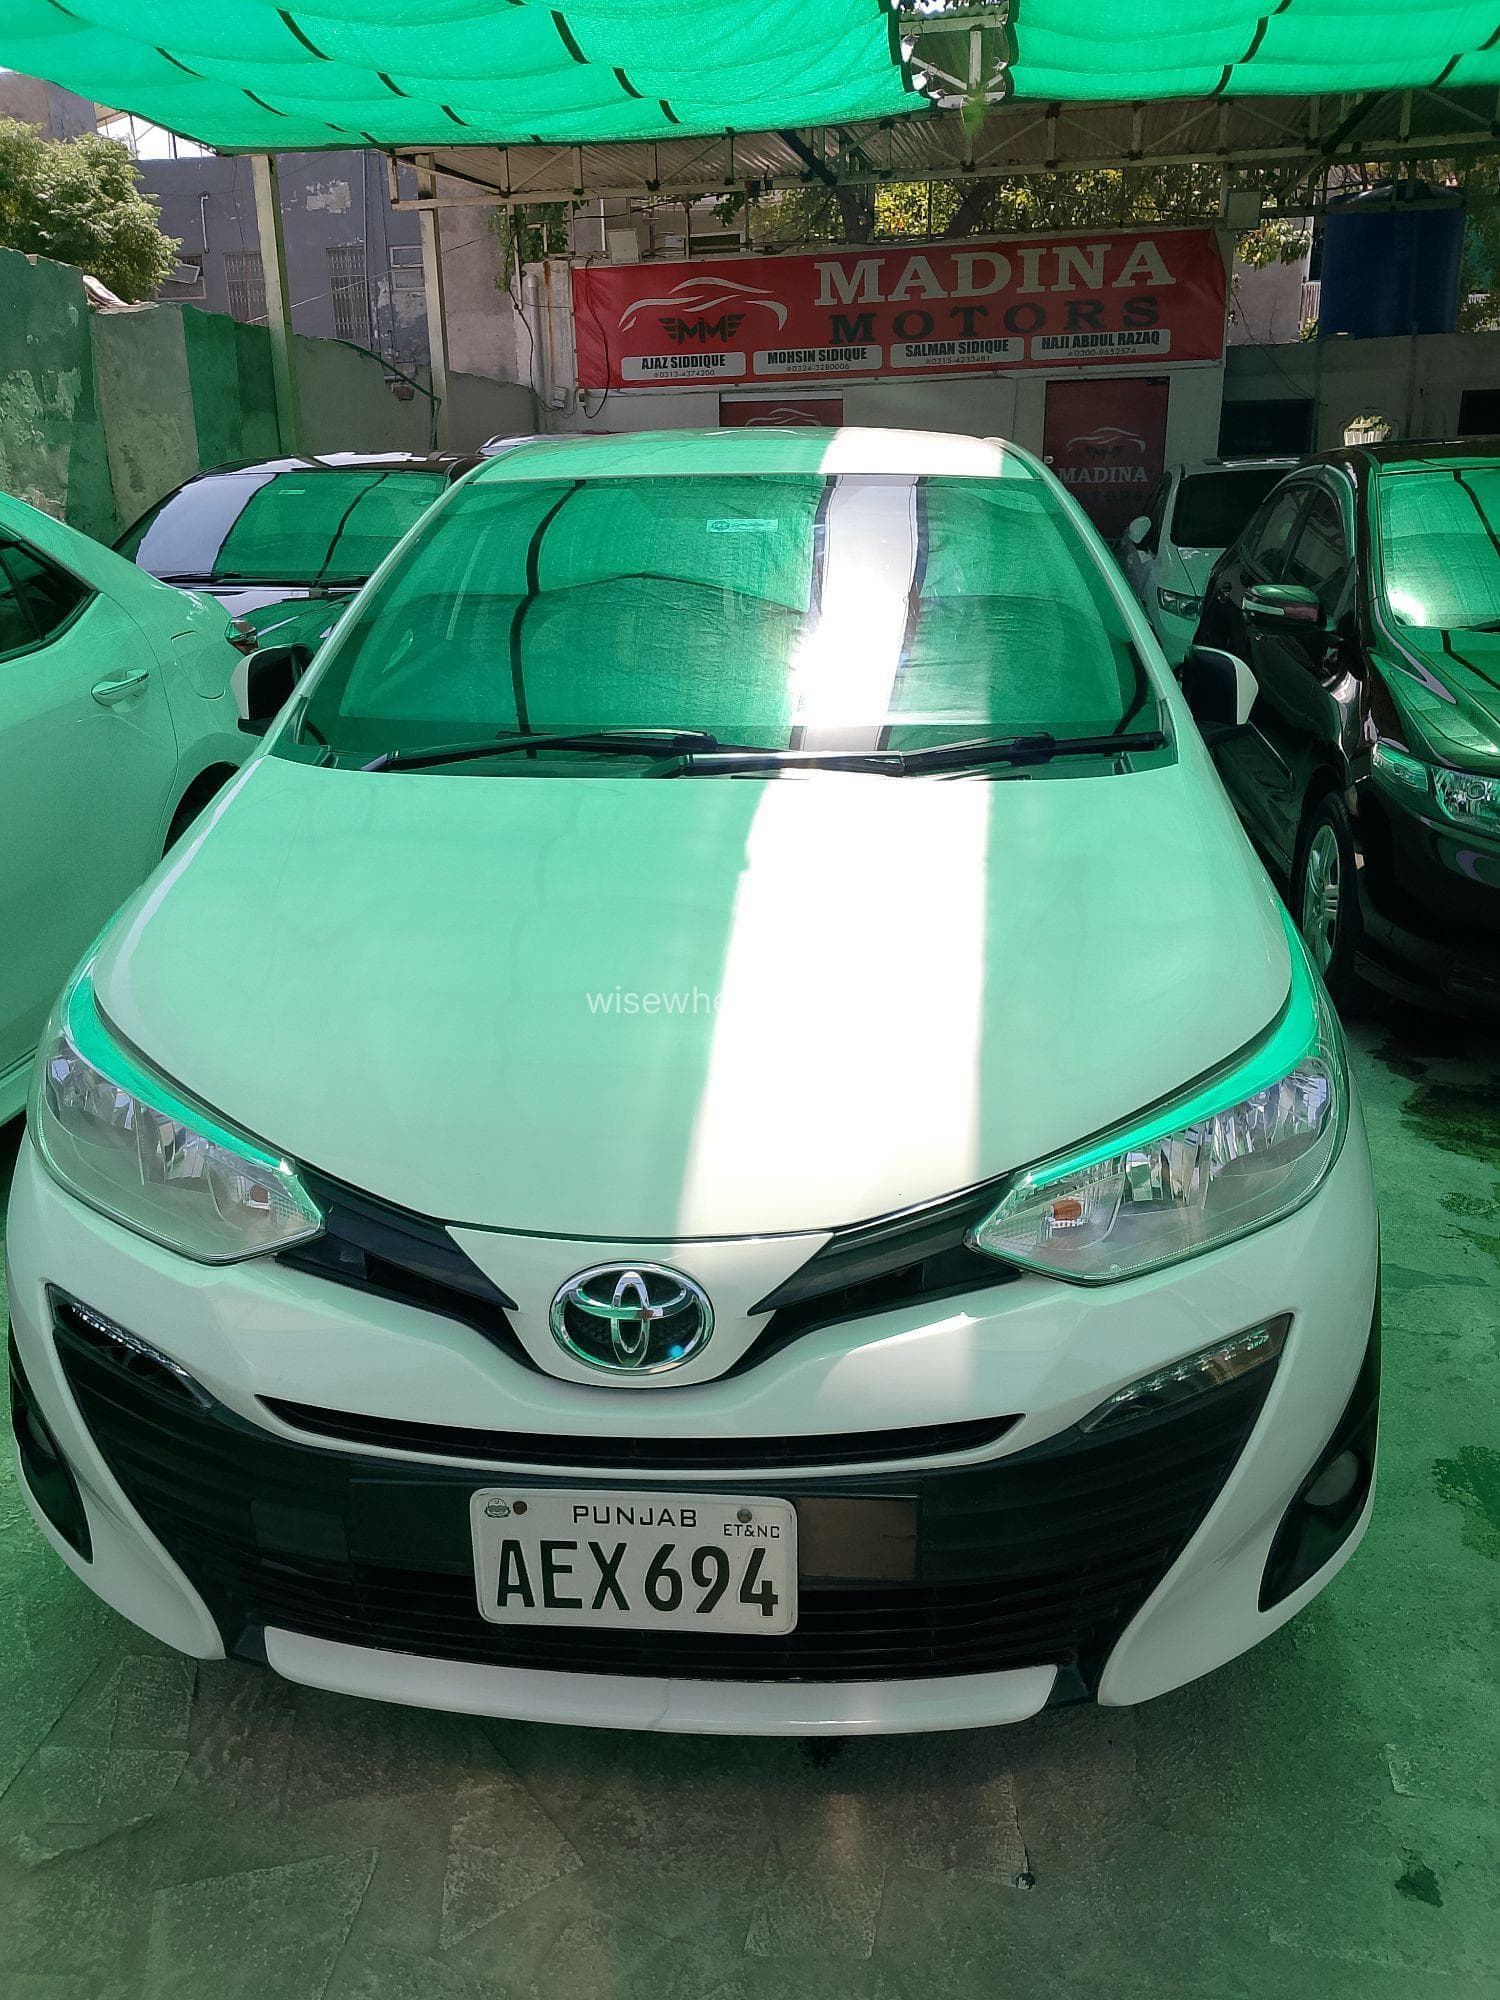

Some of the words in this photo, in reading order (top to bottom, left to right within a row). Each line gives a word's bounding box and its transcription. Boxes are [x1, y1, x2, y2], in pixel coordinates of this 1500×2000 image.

[814, 240, 1177, 306] MADINA
[829, 297, 1160, 343] MOTORS
[905, 342, 956, 358] SALMAN
[958, 339, 1009, 354] SIDIQUE
[1041, 336, 1070, 349] HAJI
[1072, 333, 1115, 348] ABDUL
[1117, 330, 1160, 346] RAZAQ
[641, 357, 668, 370] AJAZ
[670, 354, 726, 369] SIDDIQUE
[767, 350, 816, 365] MOHSIN
[818, 347, 868, 362] SIDIQUE
[1058, 466, 1148, 483] MADINA
[572, 1504, 698, 1528] PUNJAB
[723, 1523, 781, 1539] ET&NC
